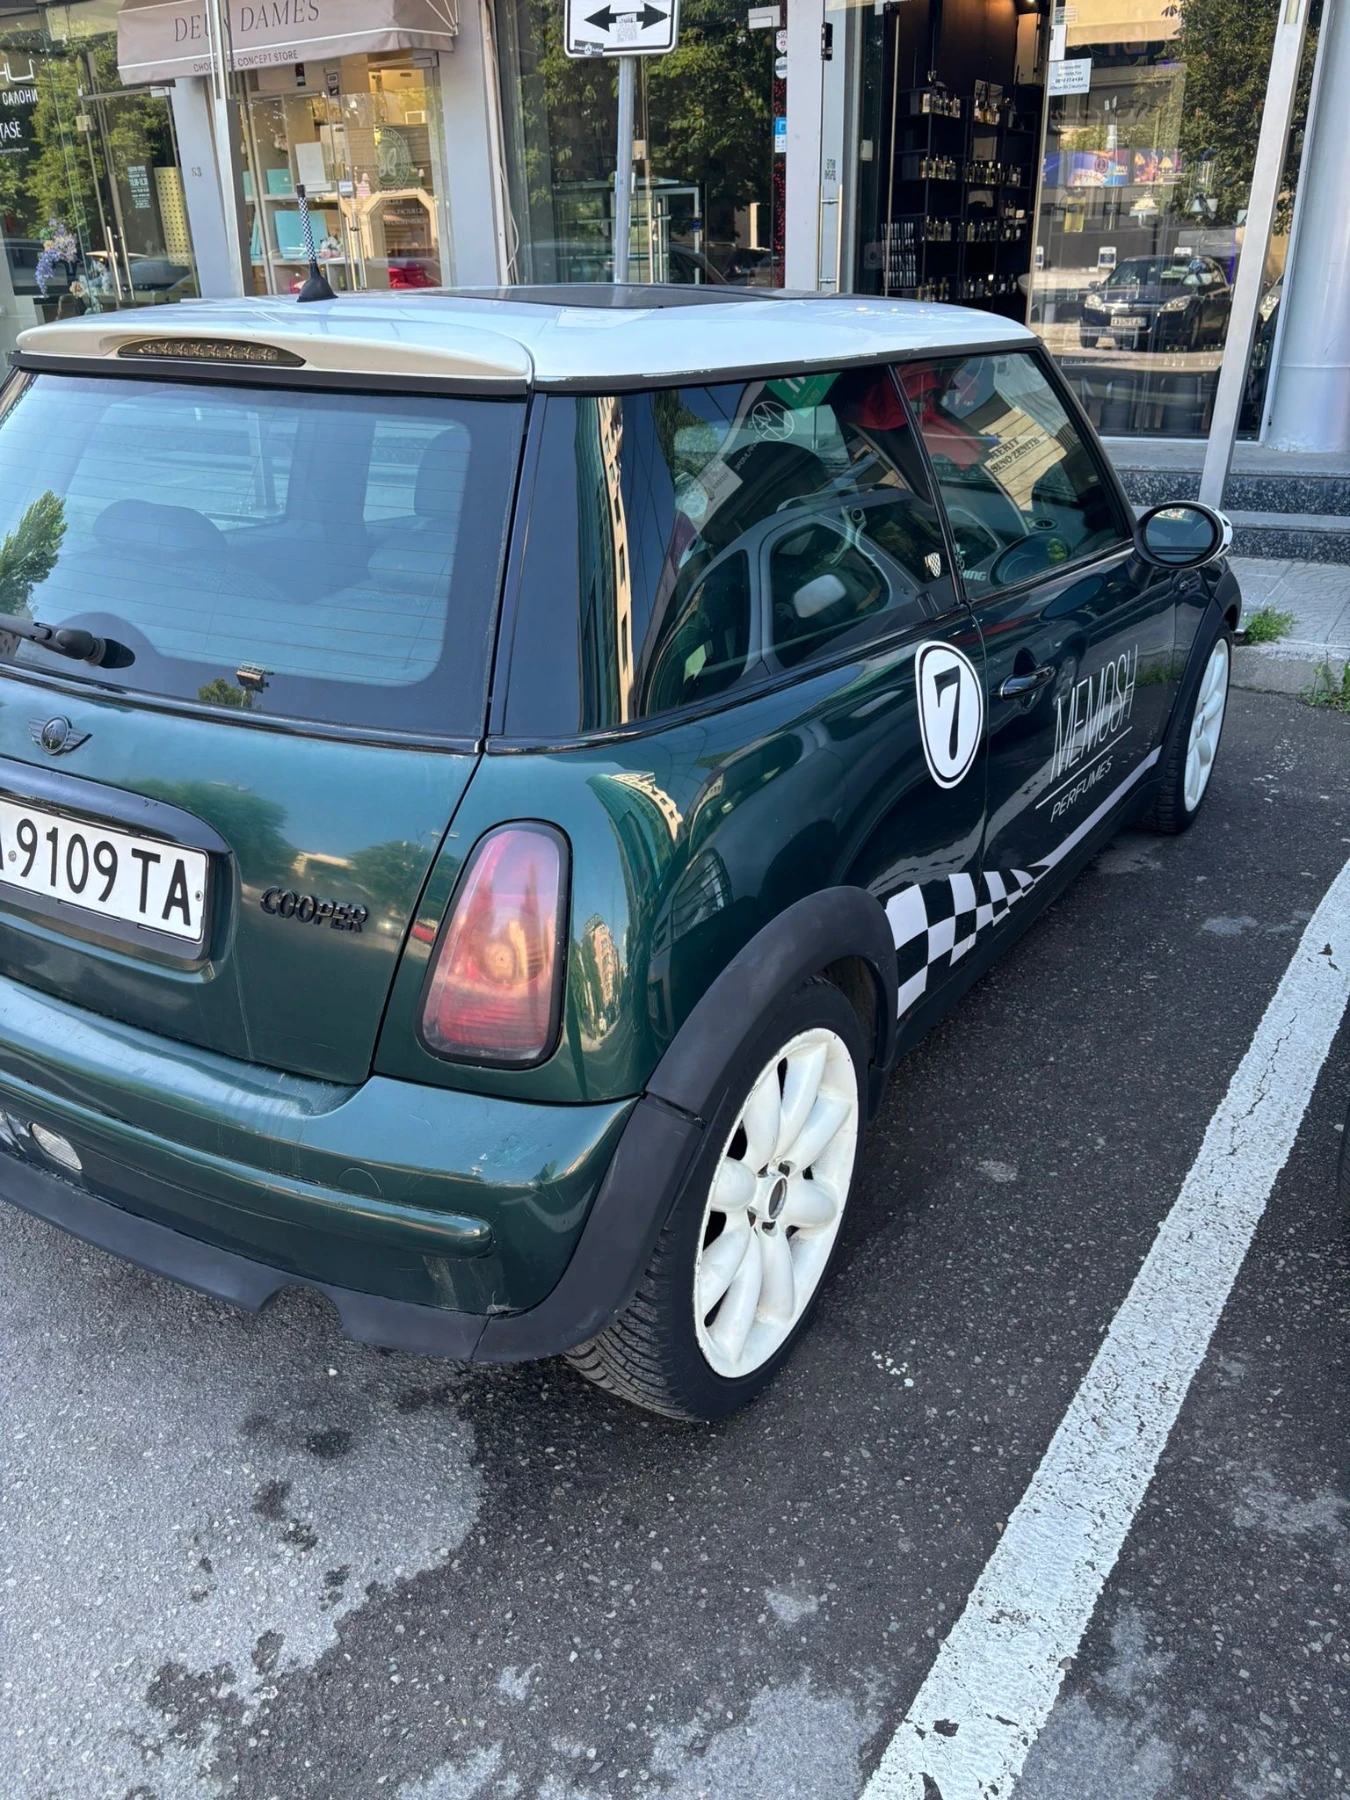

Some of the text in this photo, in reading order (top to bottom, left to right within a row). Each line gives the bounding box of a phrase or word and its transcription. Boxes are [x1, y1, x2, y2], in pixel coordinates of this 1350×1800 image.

[240, 0, 320, 32] DAMES
[238, 53, 272, 68] CONCEPT
[274, 50, 299, 63] STORE
[933, 665, 961, 761] 7
[1050, 644, 1138, 783] MEMOSH
[1050, 755, 1114, 823] PERFUMES
[16, 818, 118, 903] 9109
[131, 847, 191, 927] TA
[260, 885, 369, 933] COOPER
